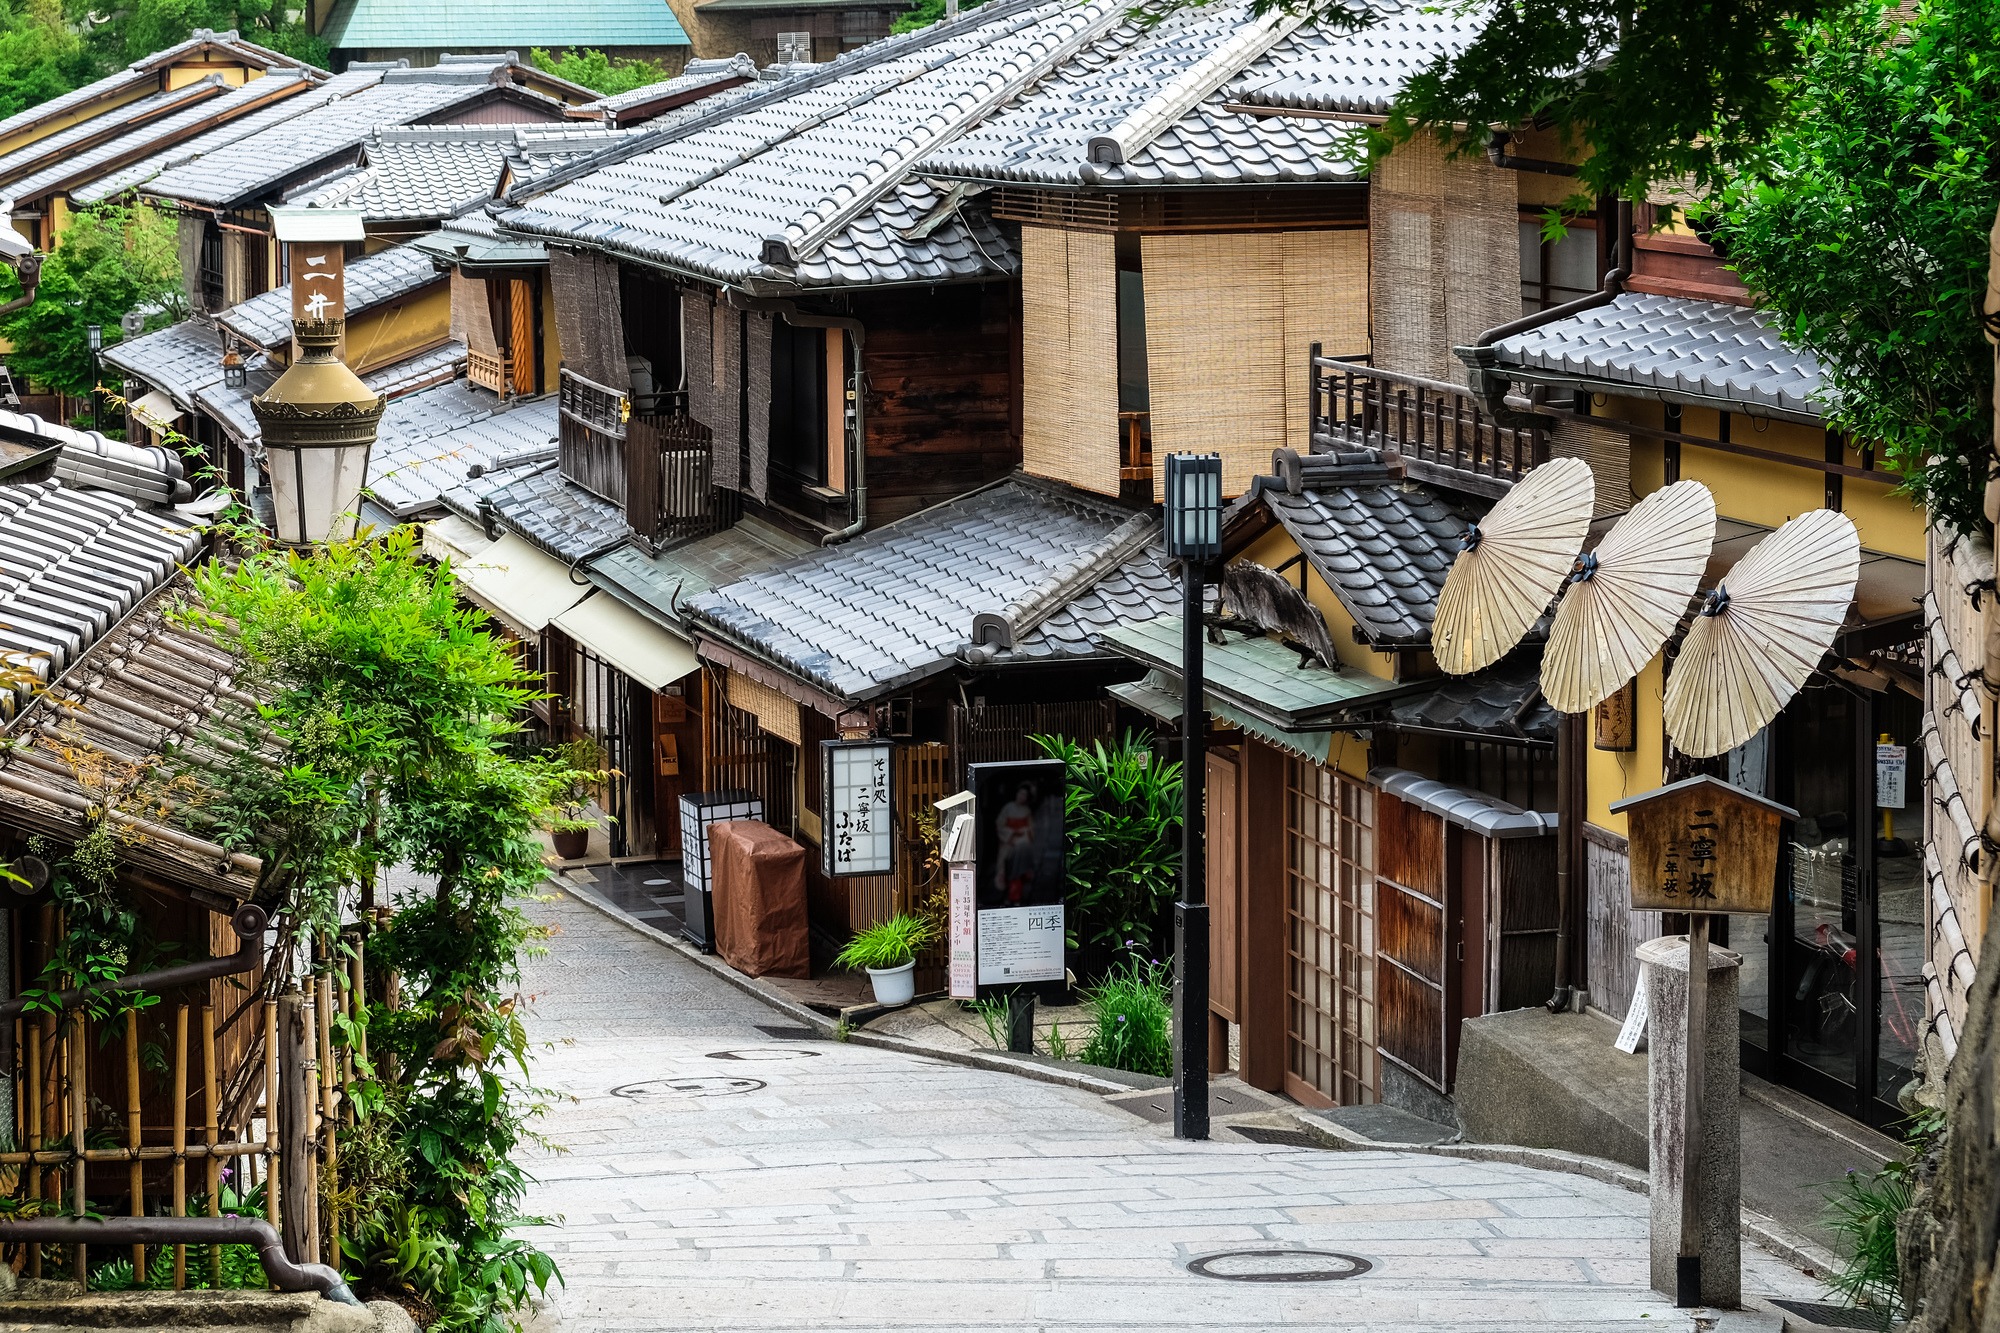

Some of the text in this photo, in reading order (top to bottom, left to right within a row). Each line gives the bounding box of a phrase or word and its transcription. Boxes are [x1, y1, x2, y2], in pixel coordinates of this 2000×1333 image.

[873, 758, 887, 803] そば処
[856, 787, 871, 833] 二寧坂
[836, 811, 856, 863] ふたば
[1686, 809, 1719, 900] 二寧坂
[1028, 914, 1062, 932] 四季
